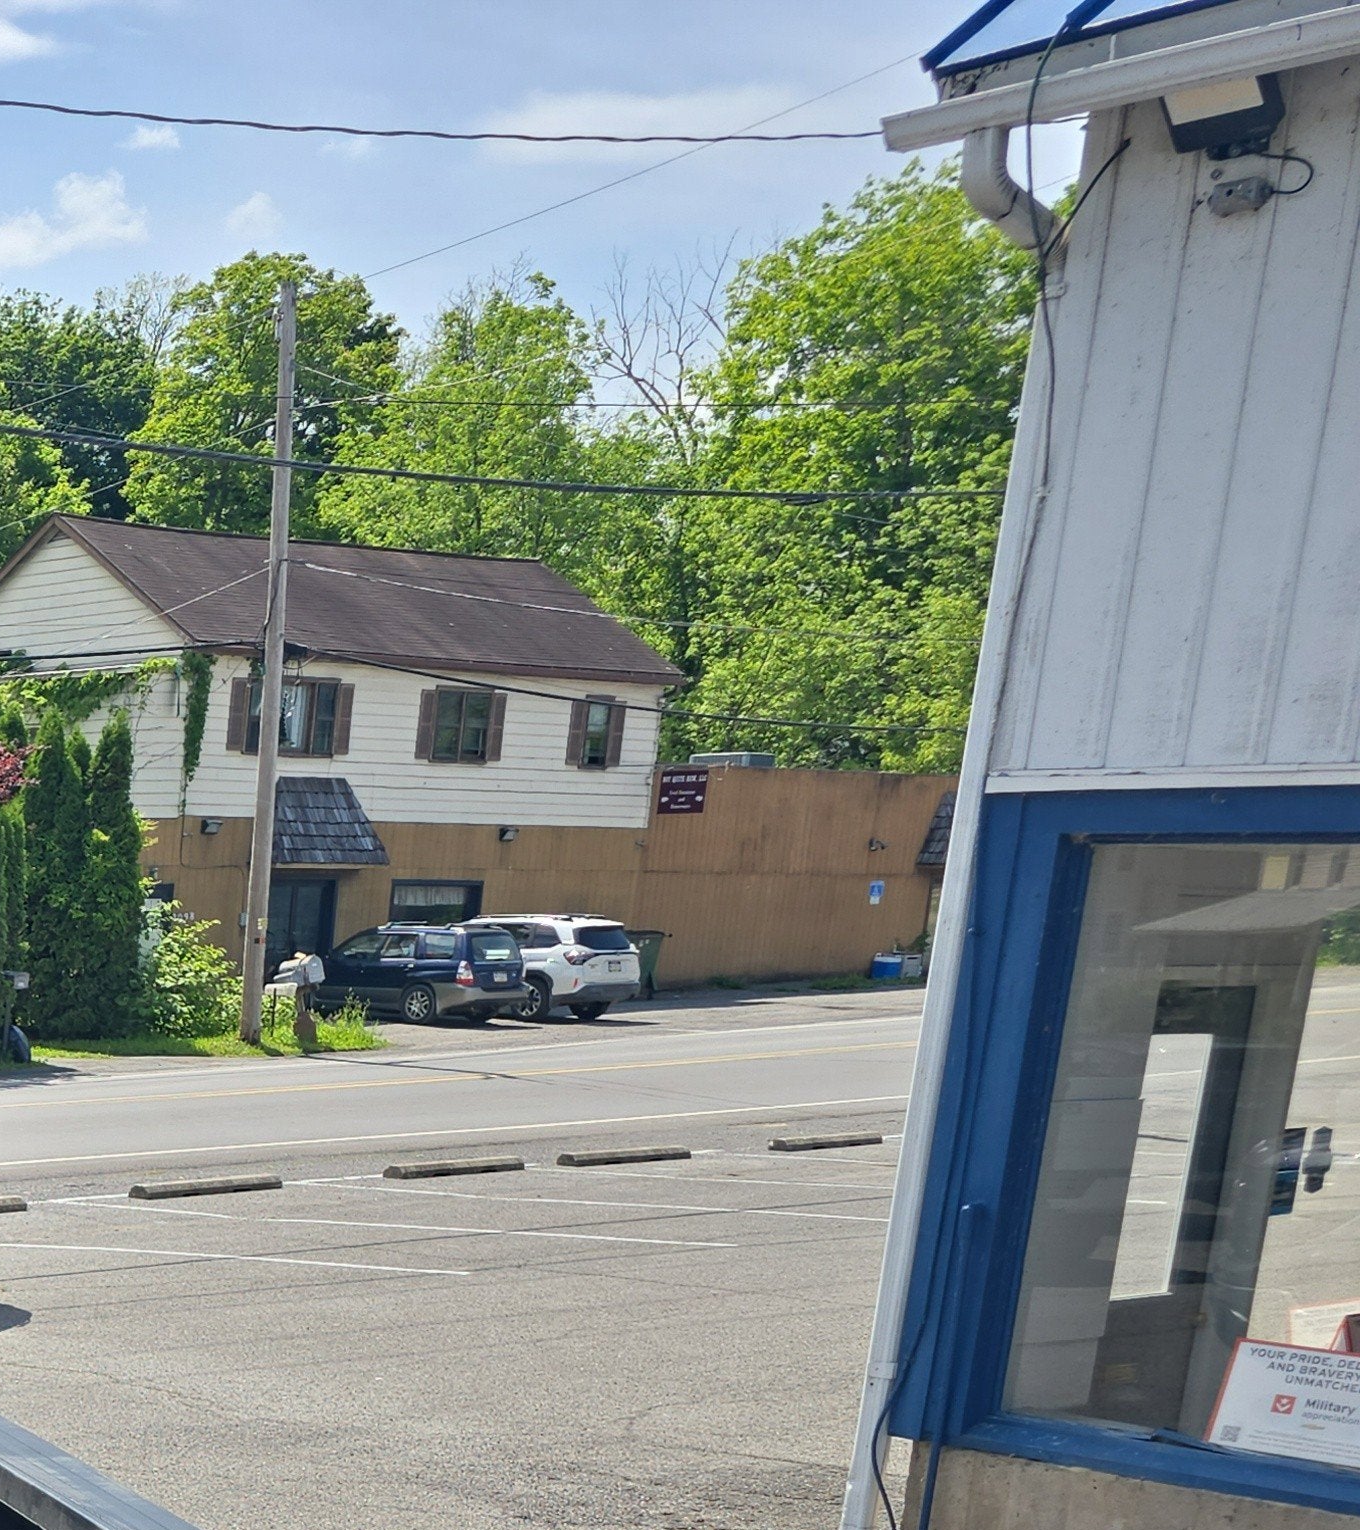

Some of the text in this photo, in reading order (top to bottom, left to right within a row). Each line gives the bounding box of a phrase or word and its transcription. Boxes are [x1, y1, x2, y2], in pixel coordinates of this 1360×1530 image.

[1249, 1347, 1286, 1359] YOUR
[1288, 1352, 1333, 1367] PRIDE,
[1266, 1361, 1360, 1381] AND BRAVERY
[1284, 1374, 1360, 1394] UNMATCHE
[1304, 1398, 1356, 1416] Military
[1301, 1411, 1360, 1426] appreciation
